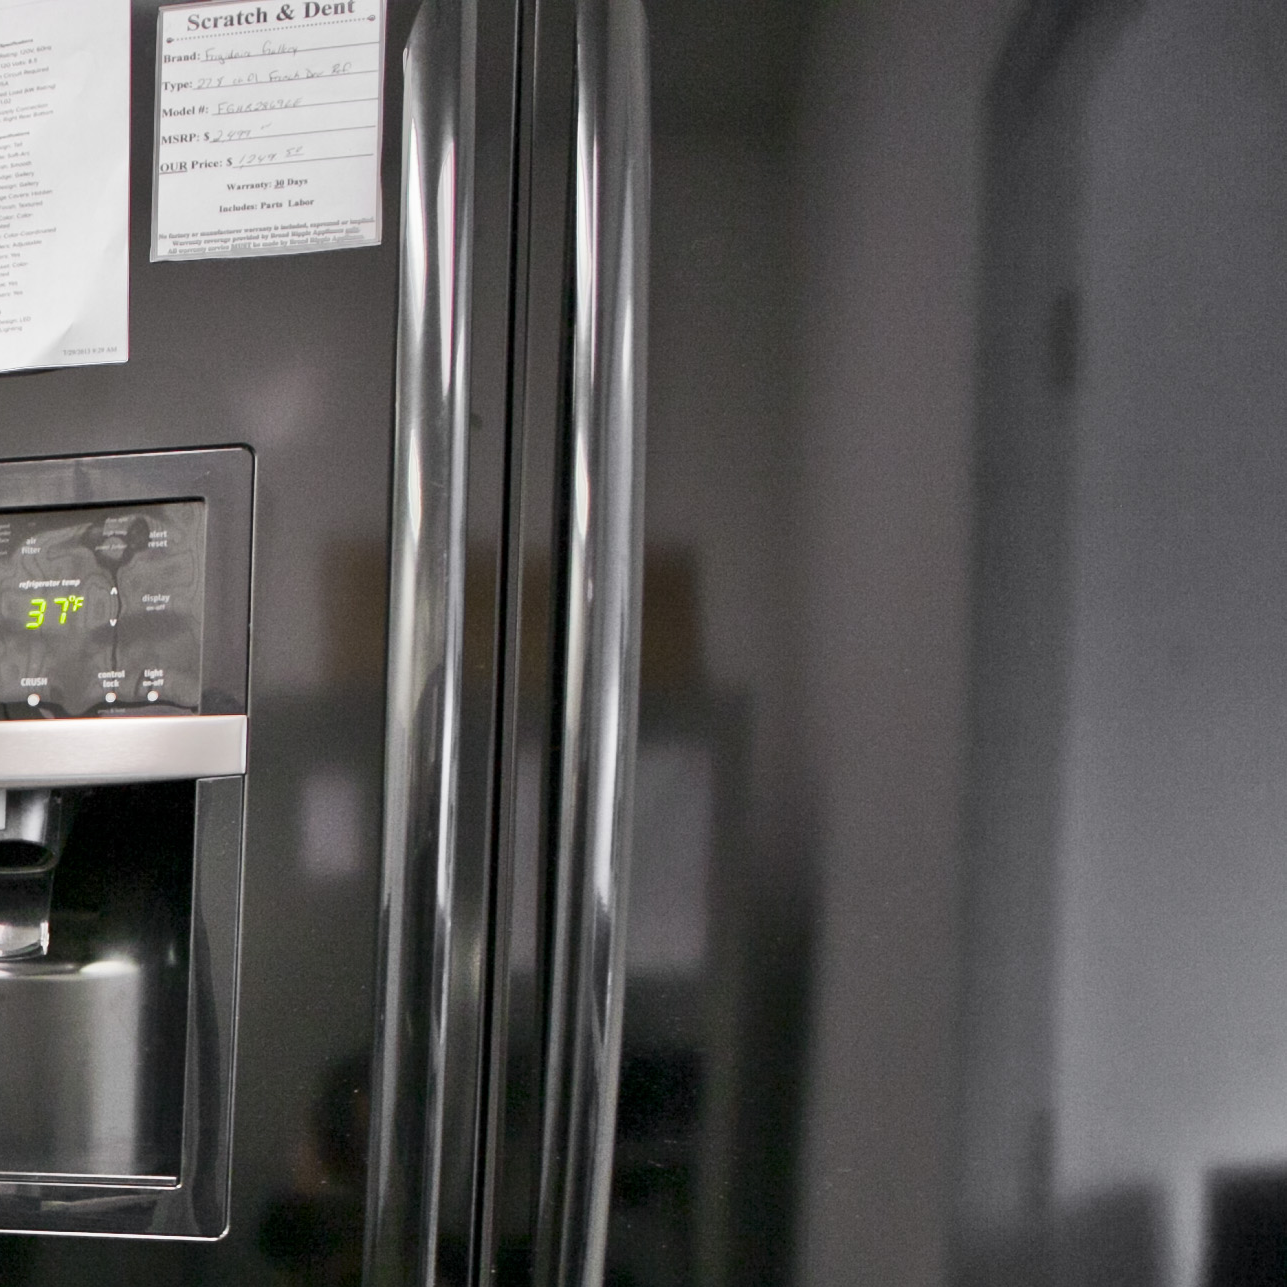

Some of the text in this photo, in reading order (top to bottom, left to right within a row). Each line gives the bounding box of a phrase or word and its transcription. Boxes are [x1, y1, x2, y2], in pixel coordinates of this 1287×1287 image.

[187, 1, 356, 31] Scratch & Dent
[164, 51, 200, 63] Brand:
[163, 80, 193, 92] Type:
[162, 106, 195, 118] Model
[197, 105, 209, 114] #:
[161, 134, 200, 145] MSRP:
[203, 132, 210, 142] $
[160, 162, 188, 173] OUR
[191, 159, 223, 170] Price:
[226, 157, 233, 167] $
[226, 181, 271, 191] Warranty:
[287, 177, 308, 187] Days
[219, 199, 314, 213] Includes: Parts Labor
[149, 530, 167, 539] alert
[26, 537, 37, 545] air
[148, 539, 168, 547] reset
[21, 546, 41, 555] filter
[19, 579, 80, 589] refrigerator temp
[142, 594, 170, 603] display
[98, 670, 125, 679] control
[144, 668, 164, 679] light
[21, 677, 48, 687] CRUSH
[103, 679, 119, 688] lock
